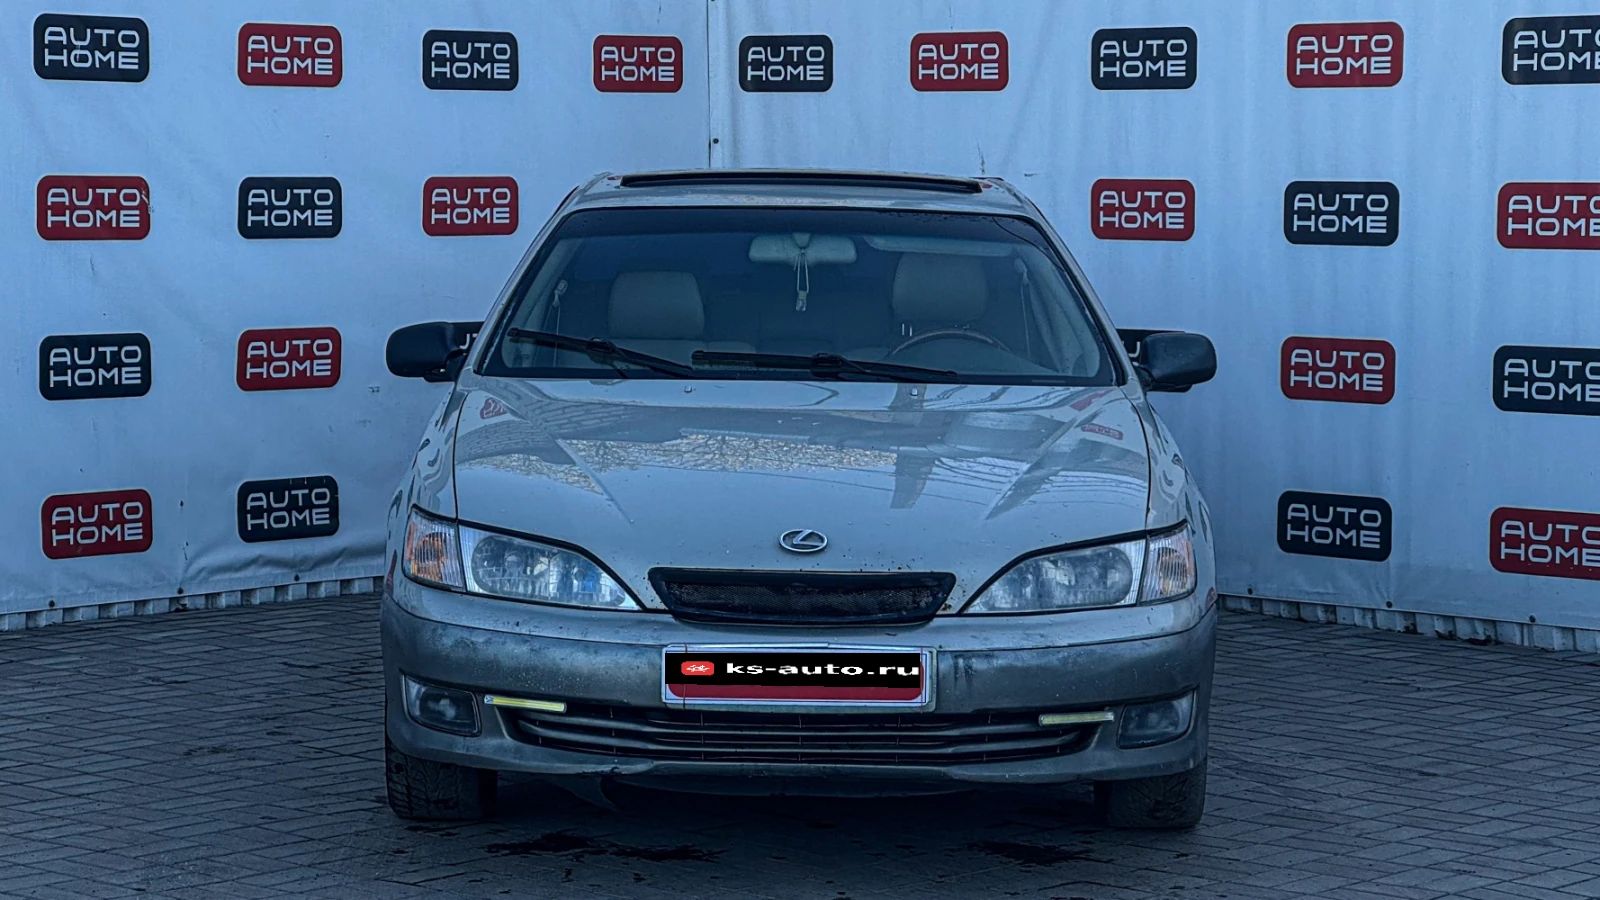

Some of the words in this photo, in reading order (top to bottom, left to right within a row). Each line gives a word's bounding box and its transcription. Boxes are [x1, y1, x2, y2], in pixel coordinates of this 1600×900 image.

[45, 27, 139, 48] AUTO
[248, 36, 333, 54] AUTO
[1297, 35, 1393, 53] AUTO
[1514, 29, 1600, 49] AUT
[432, 42, 510, 59] AUTO
[601, 47, 675, 62] AUTO
[748, 46, 824, 62] AUTO
[919, 44, 999, 60] AUTO
[1100, 39, 1187, 57] AUTO
[45, 49, 138, 69] HOME
[248, 56, 332, 75] HOME
[1297, 57, 1391, 75] HOME
[1513, 52, 1600, 71] HOM
[432, 61, 510, 79] HOME
[602, 65, 674, 81] HOME
[747, 65, 823, 80] HOME
[919, 63, 998, 79] HOME
[1100, 60, 1186, 77] HOME
[48, 189, 140, 206] AUTO
[248, 189, 333, 205] AUTO
[432, 188, 510, 204] AUTO
[1100, 191, 1185, 208] AUTO
[1294, 194, 1388, 211] AUTO
[48, 210, 139, 227] HOME
[248, 209, 332, 226] HOME
[432, 208, 509, 224] HOME
[1100, 211, 1184, 229] HOME
[1294, 215, 1387, 233] HOME
[50, 346, 141, 366] AUTO
[247, 339, 332, 358] AUTO
[1291, 349, 1384, 370] AUTO
[50, 367, 141, 387] HOME
[246, 359, 331, 379] HOME
[1290, 370, 1383, 391] HOME
[247, 488, 330, 510] AUTO
[52, 502, 143, 525] AUTO
[247, 508, 330, 530] HOME
[1288, 504, 1381, 527] AUTO
[52, 522, 142, 546] HOME
[1287, 524, 1380, 548] HOME
[1501, 521, 1600, 545] AUTO
[1501, 542, 1600, 567] HOME
